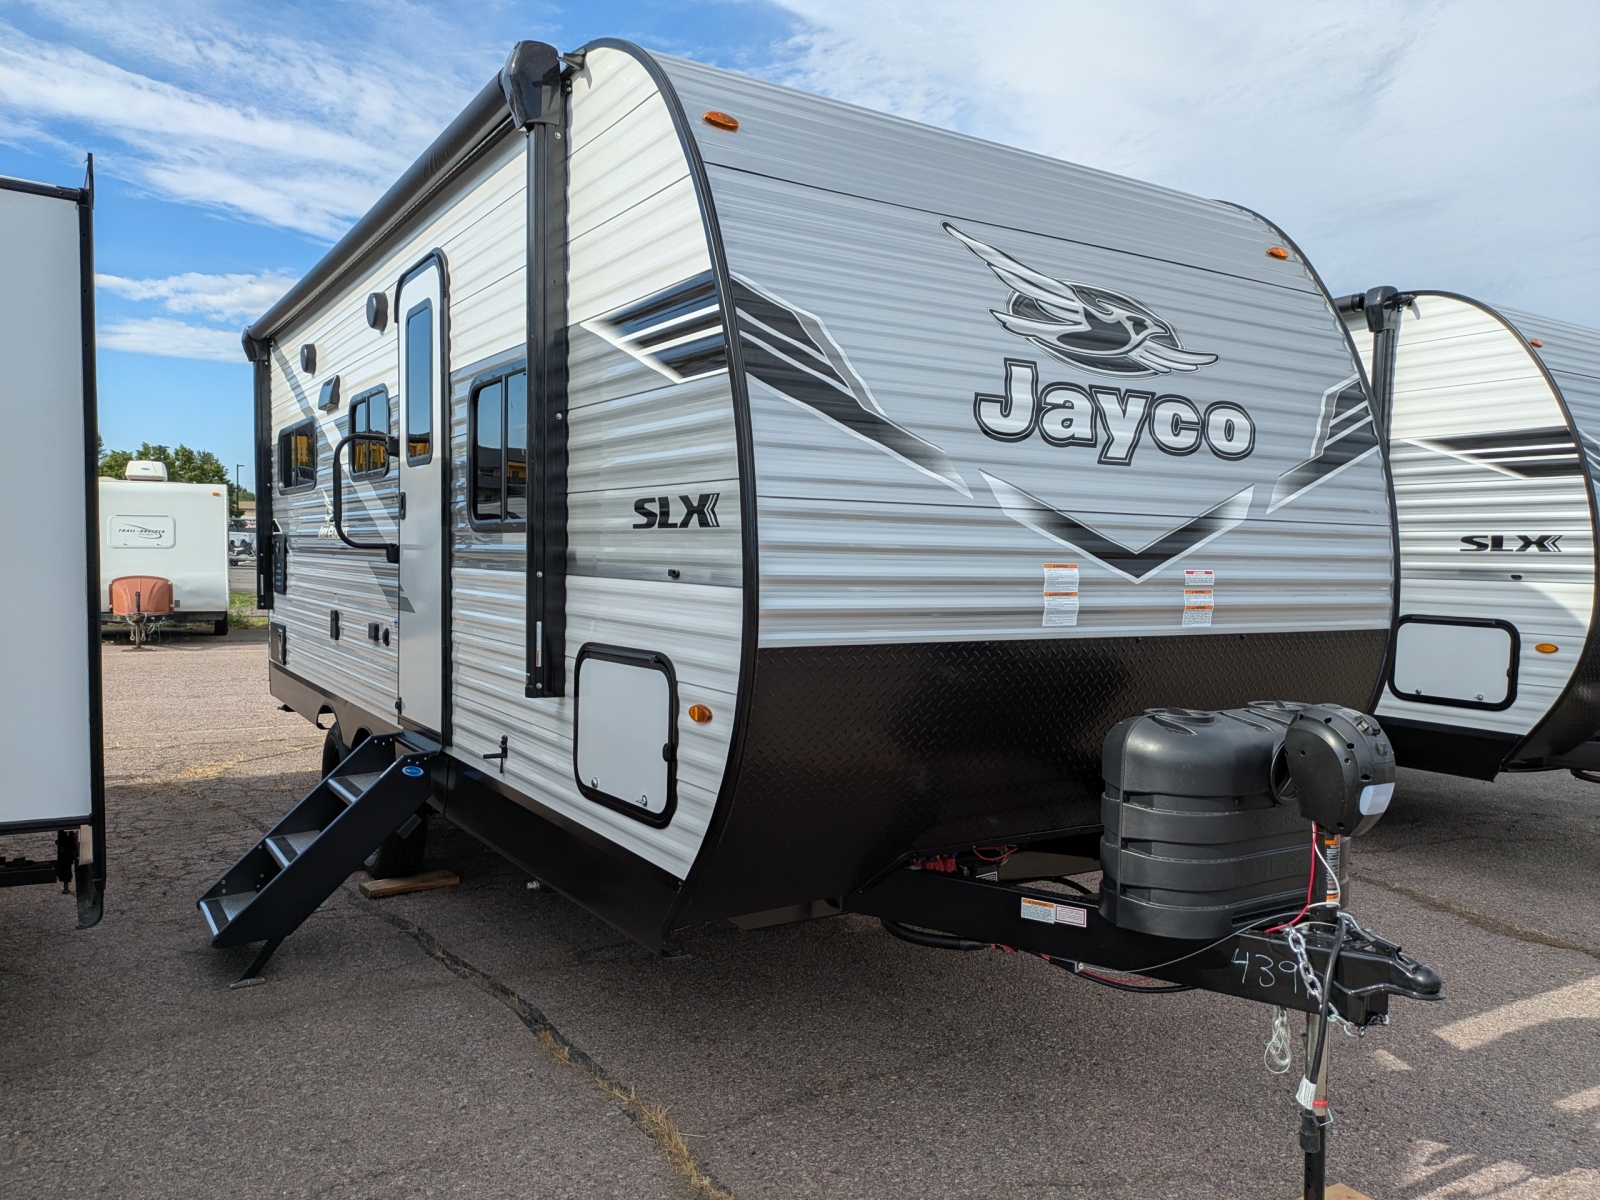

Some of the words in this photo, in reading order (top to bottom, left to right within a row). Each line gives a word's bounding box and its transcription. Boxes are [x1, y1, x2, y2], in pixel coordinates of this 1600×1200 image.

[973, 357, 1256, 466] Jayco
[633, 493, 720, 529] SLX
[1460, 535, 1563, 552] SLX
[1231, 948, 1309, 999] 439
